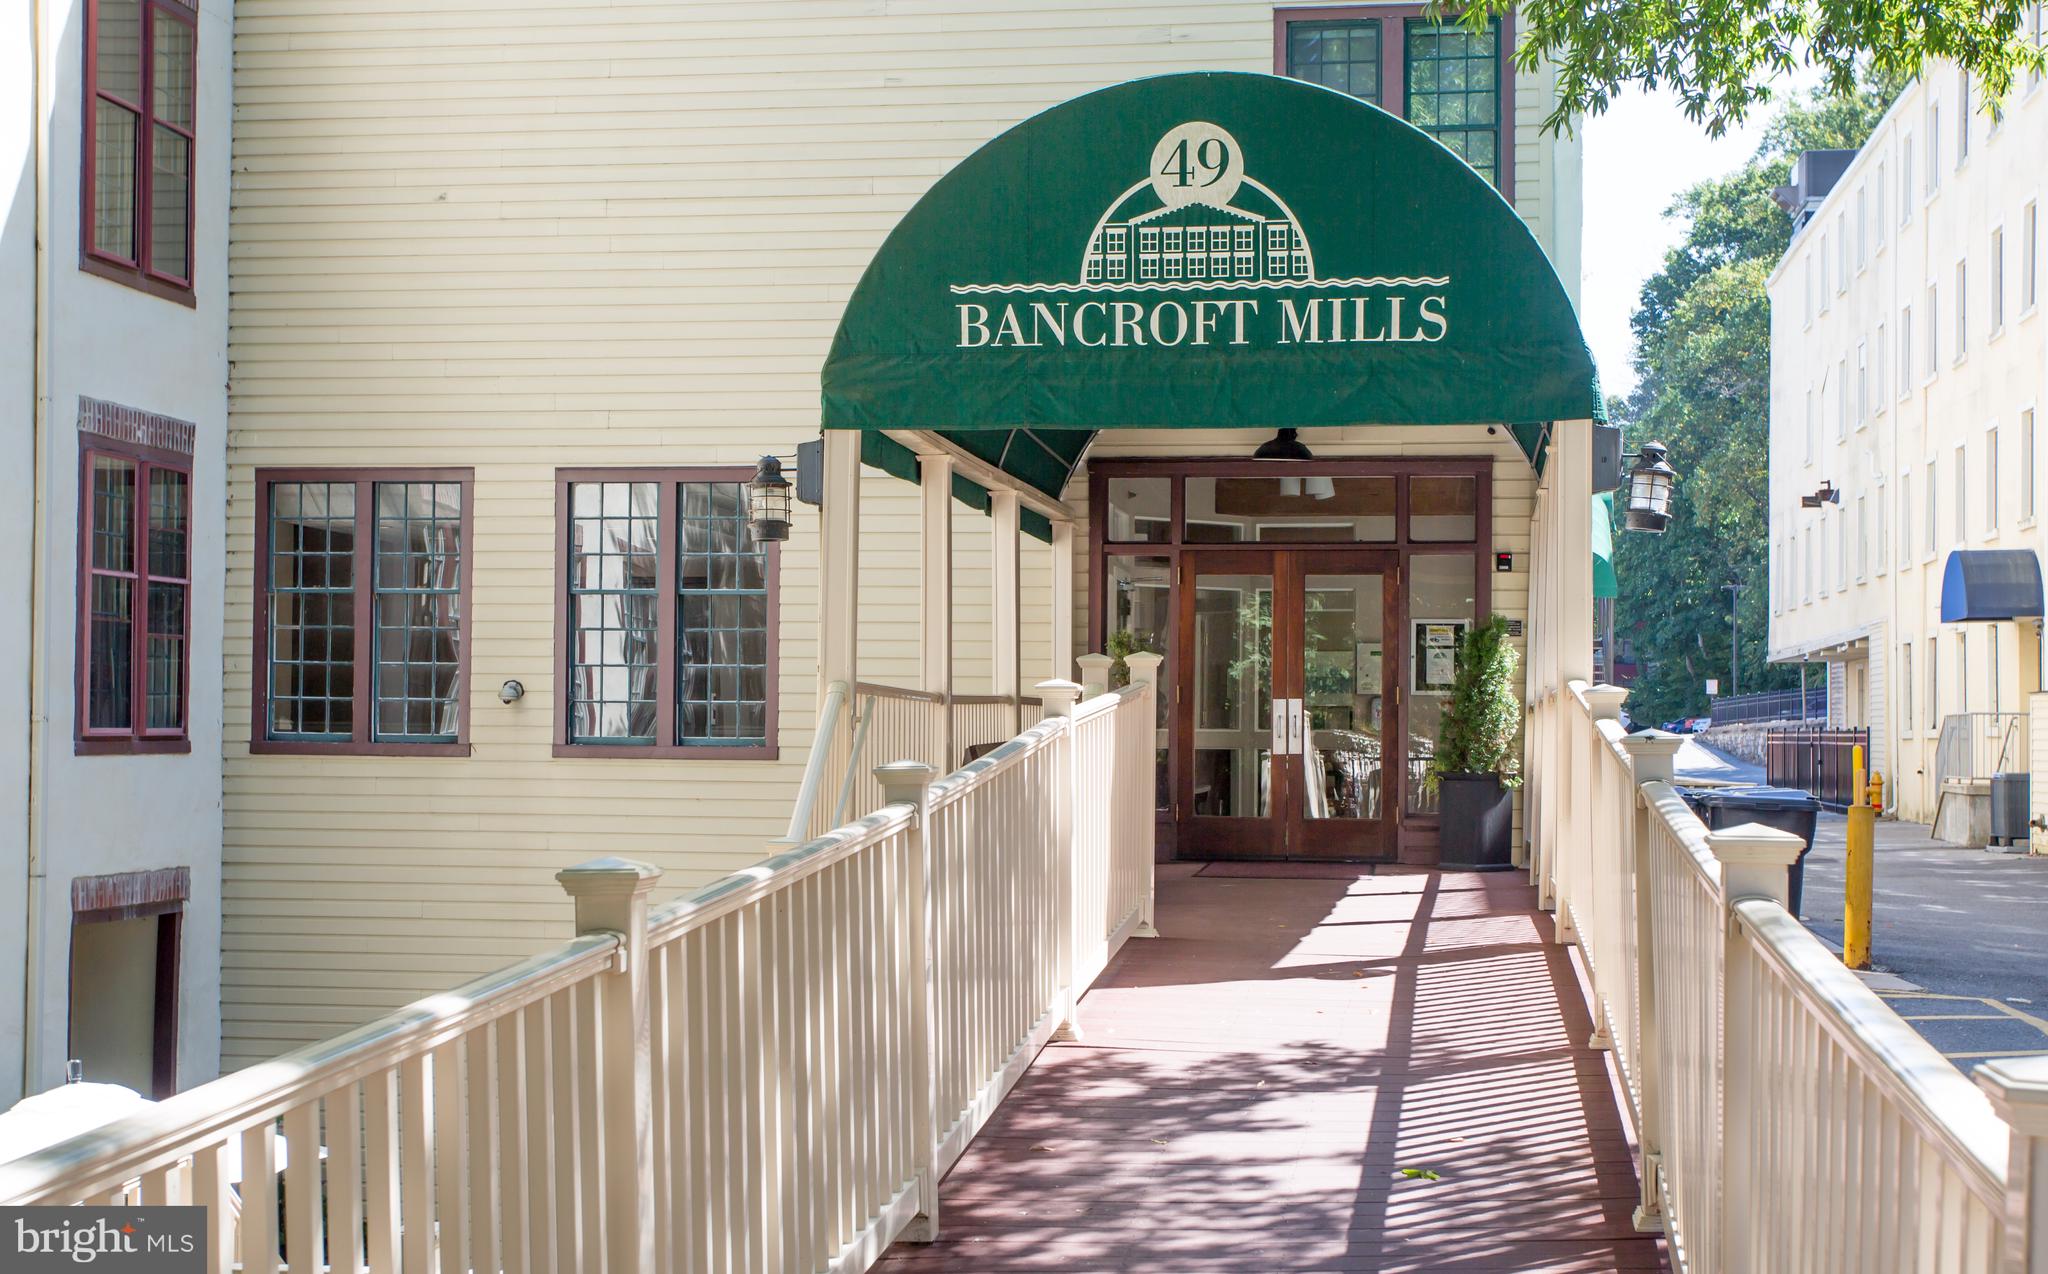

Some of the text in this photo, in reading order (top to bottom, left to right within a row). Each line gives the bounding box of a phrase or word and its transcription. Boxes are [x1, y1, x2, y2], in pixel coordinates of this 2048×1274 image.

[1160, 138, 1230, 189] 49
[955, 296, 1449, 348] BANCROFT MILLS
